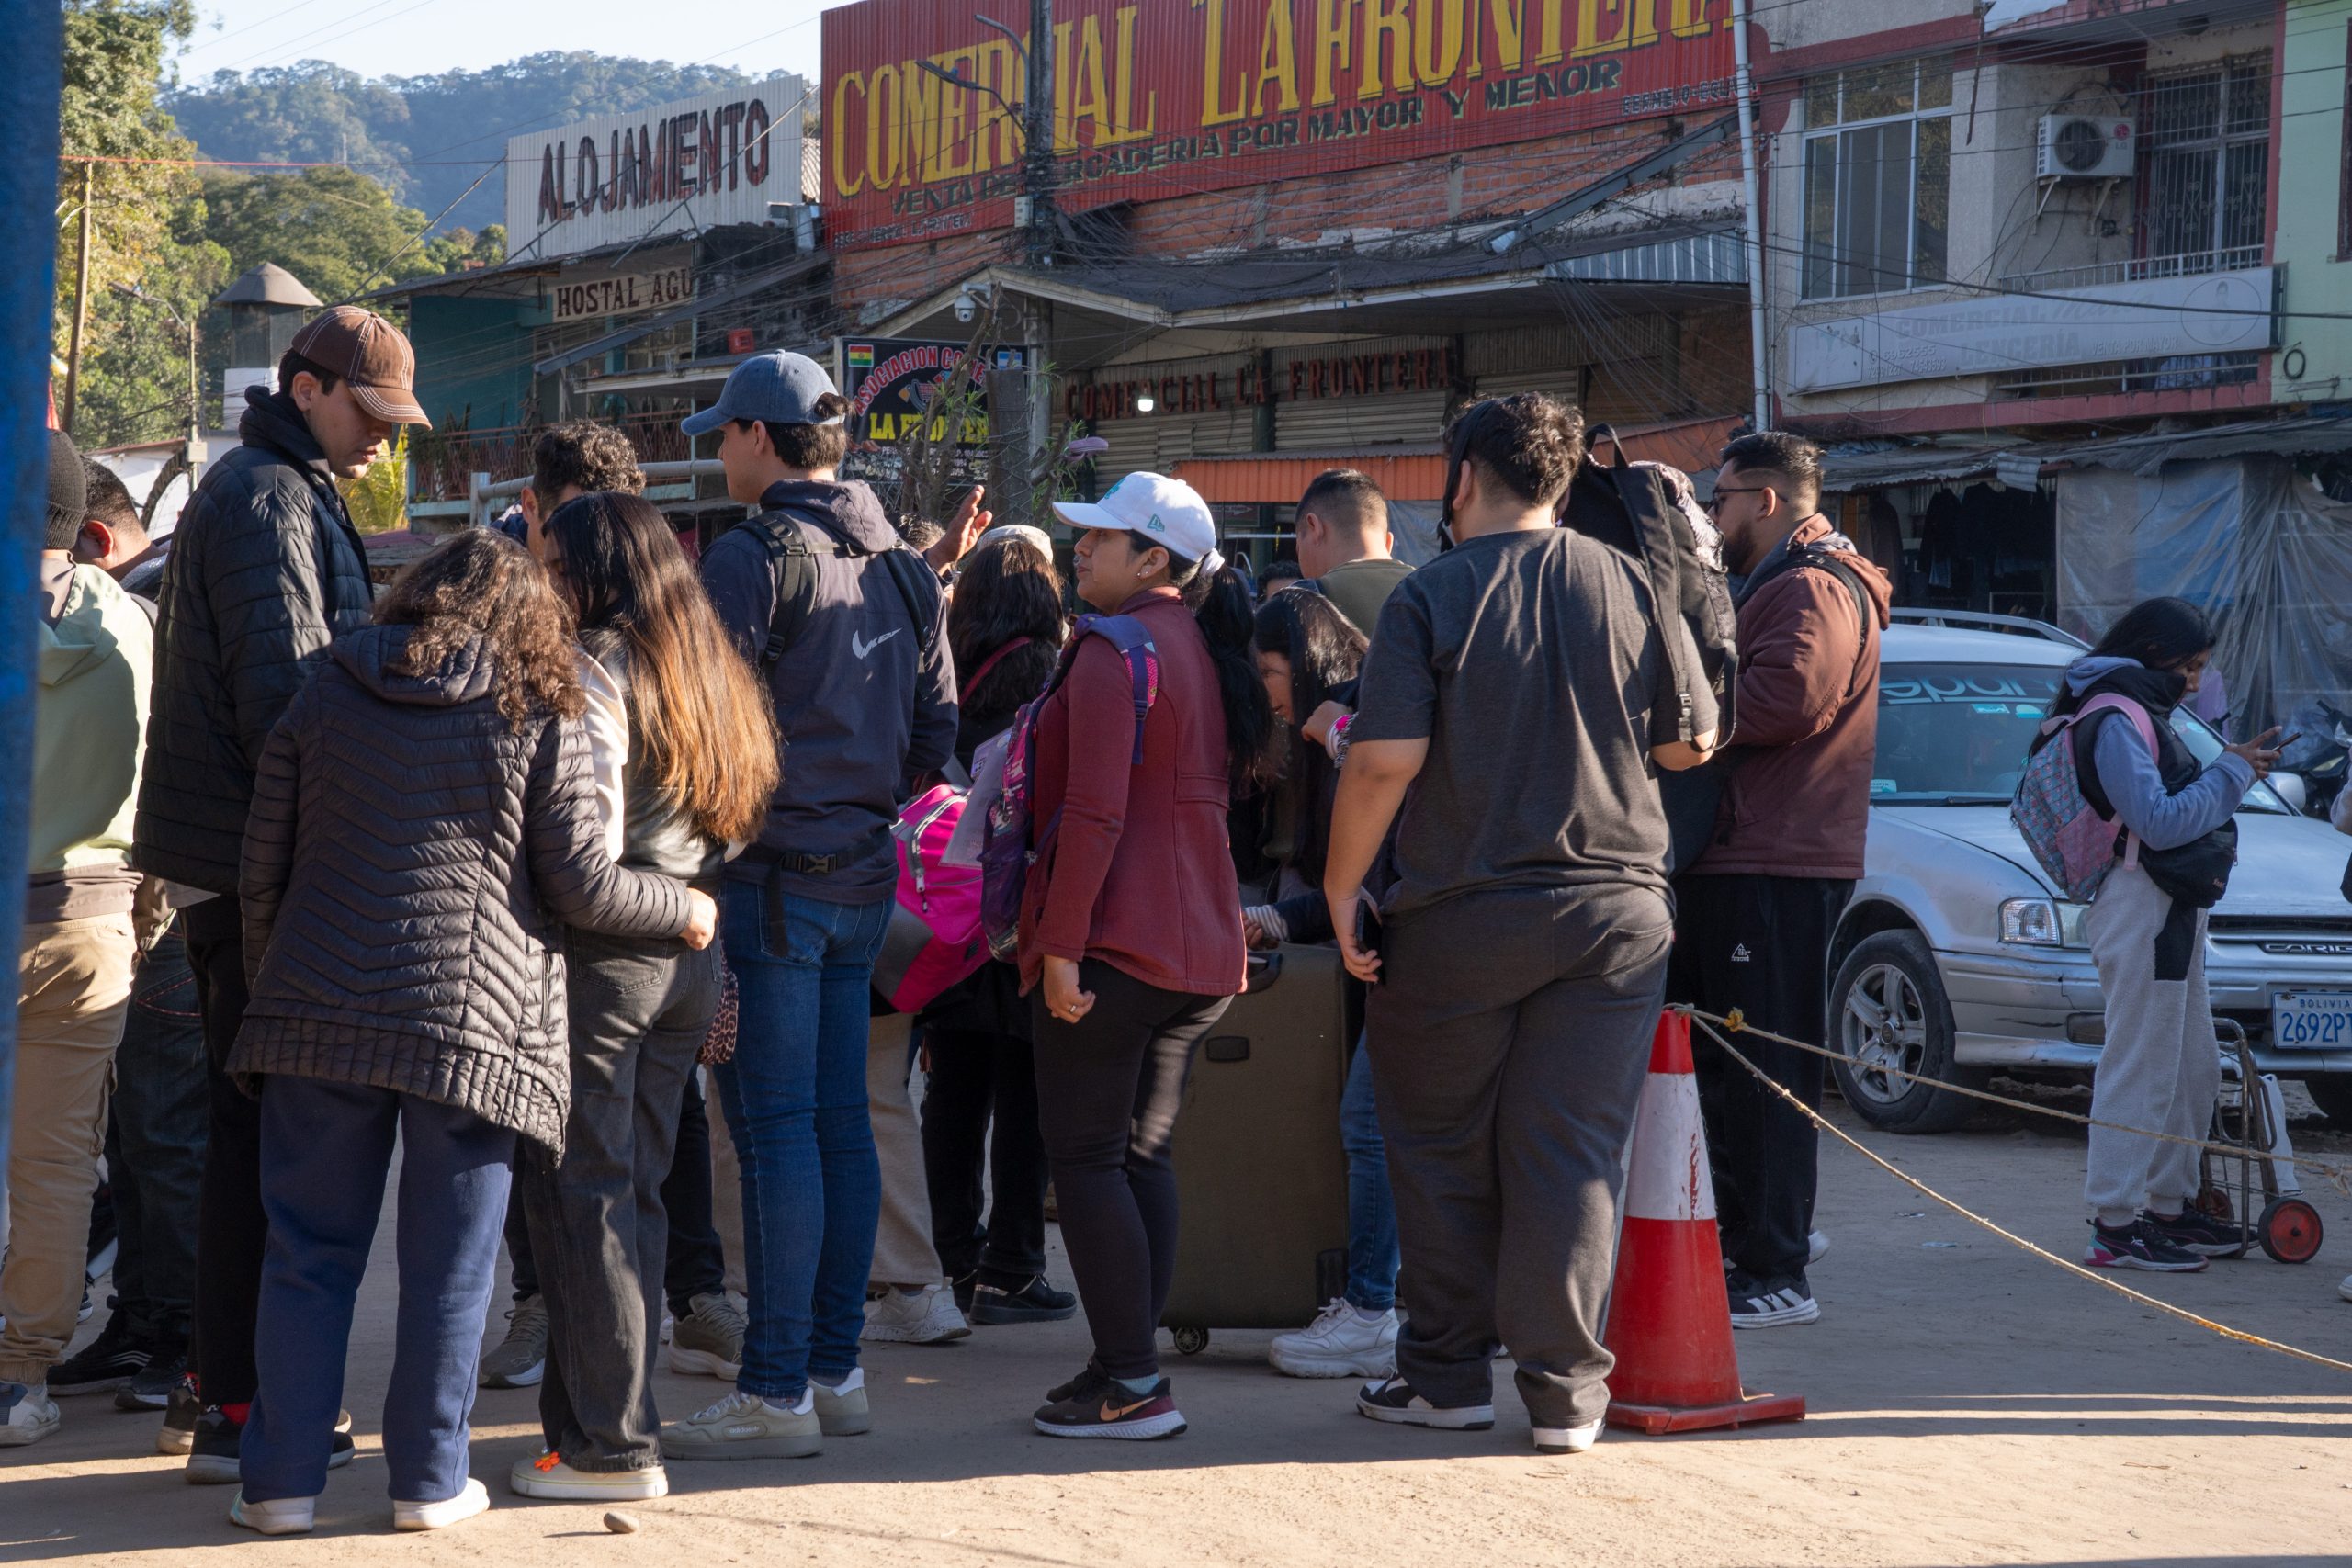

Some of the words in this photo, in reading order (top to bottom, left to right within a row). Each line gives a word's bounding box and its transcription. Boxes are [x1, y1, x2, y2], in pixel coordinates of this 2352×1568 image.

[1192, 0, 1302, 129] LA
[537, 98, 770, 226] ALOJAMIENTO
[892, 179, 975, 216] VENTA
[1058, 131, 1224, 189] RCADERIA
[1229, 118, 1301, 156] POR
[1308, 96, 1425, 144] MAYOR
[1441, 89, 1470, 119] Y
[1485, 58, 1623, 111] MENOR
[557, 277, 641, 318] HOSTAL
[1896, 304, 2047, 340] COMERCIAL
[854, 345, 939, 417] ASOCIACION
[1064, 371, 1221, 421] COMERCIAL
[1235, 366, 1266, 406] LA
[1288, 344, 1450, 401] FRONTERA
[869, 412, 896, 441] LA
[1878, 674, 2060, 704] spar
[2299, 998, 2351, 1009] BOLIVIA
